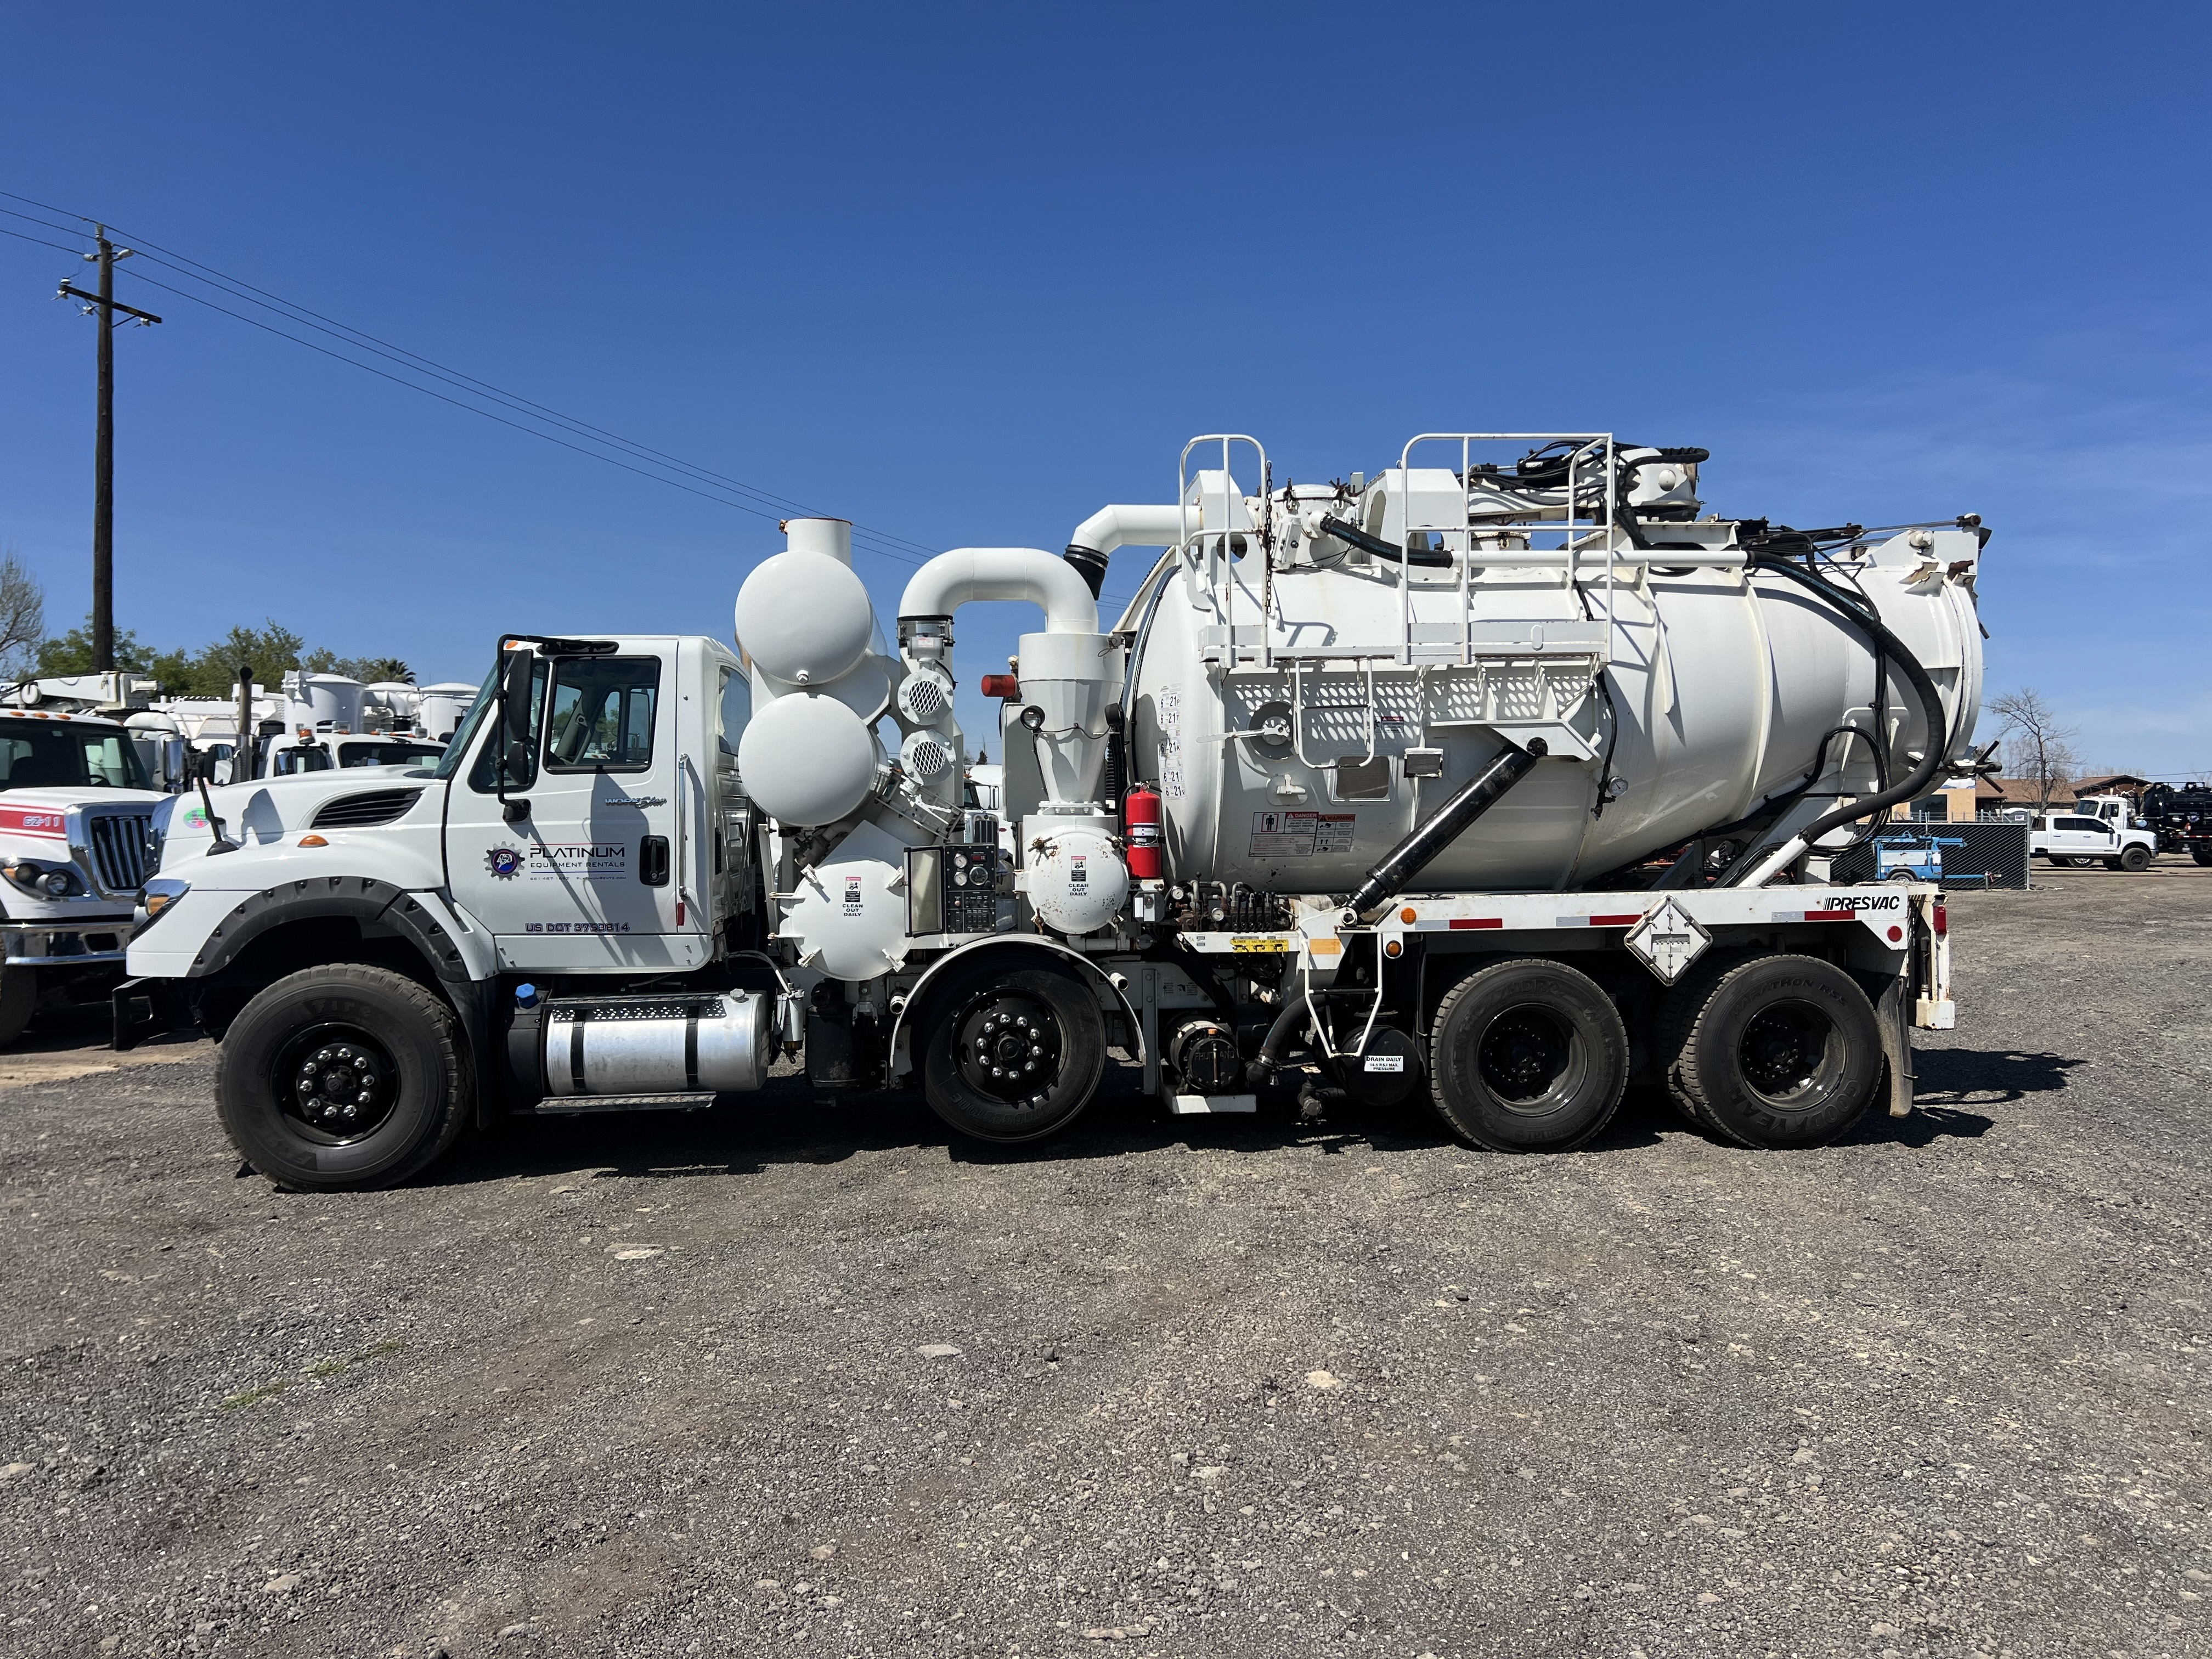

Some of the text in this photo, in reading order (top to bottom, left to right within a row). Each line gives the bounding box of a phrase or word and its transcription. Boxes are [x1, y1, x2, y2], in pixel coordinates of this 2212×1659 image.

[530, 847, 625, 858] PLATINUM
[1830, 896, 1900, 911] PRESVAC
[526, 922, 630, 932] US DOT 3753814
[1733, 978, 1814, 1017] MARATHON
[1729, 1080, 1862, 1135] GOODYEAR
